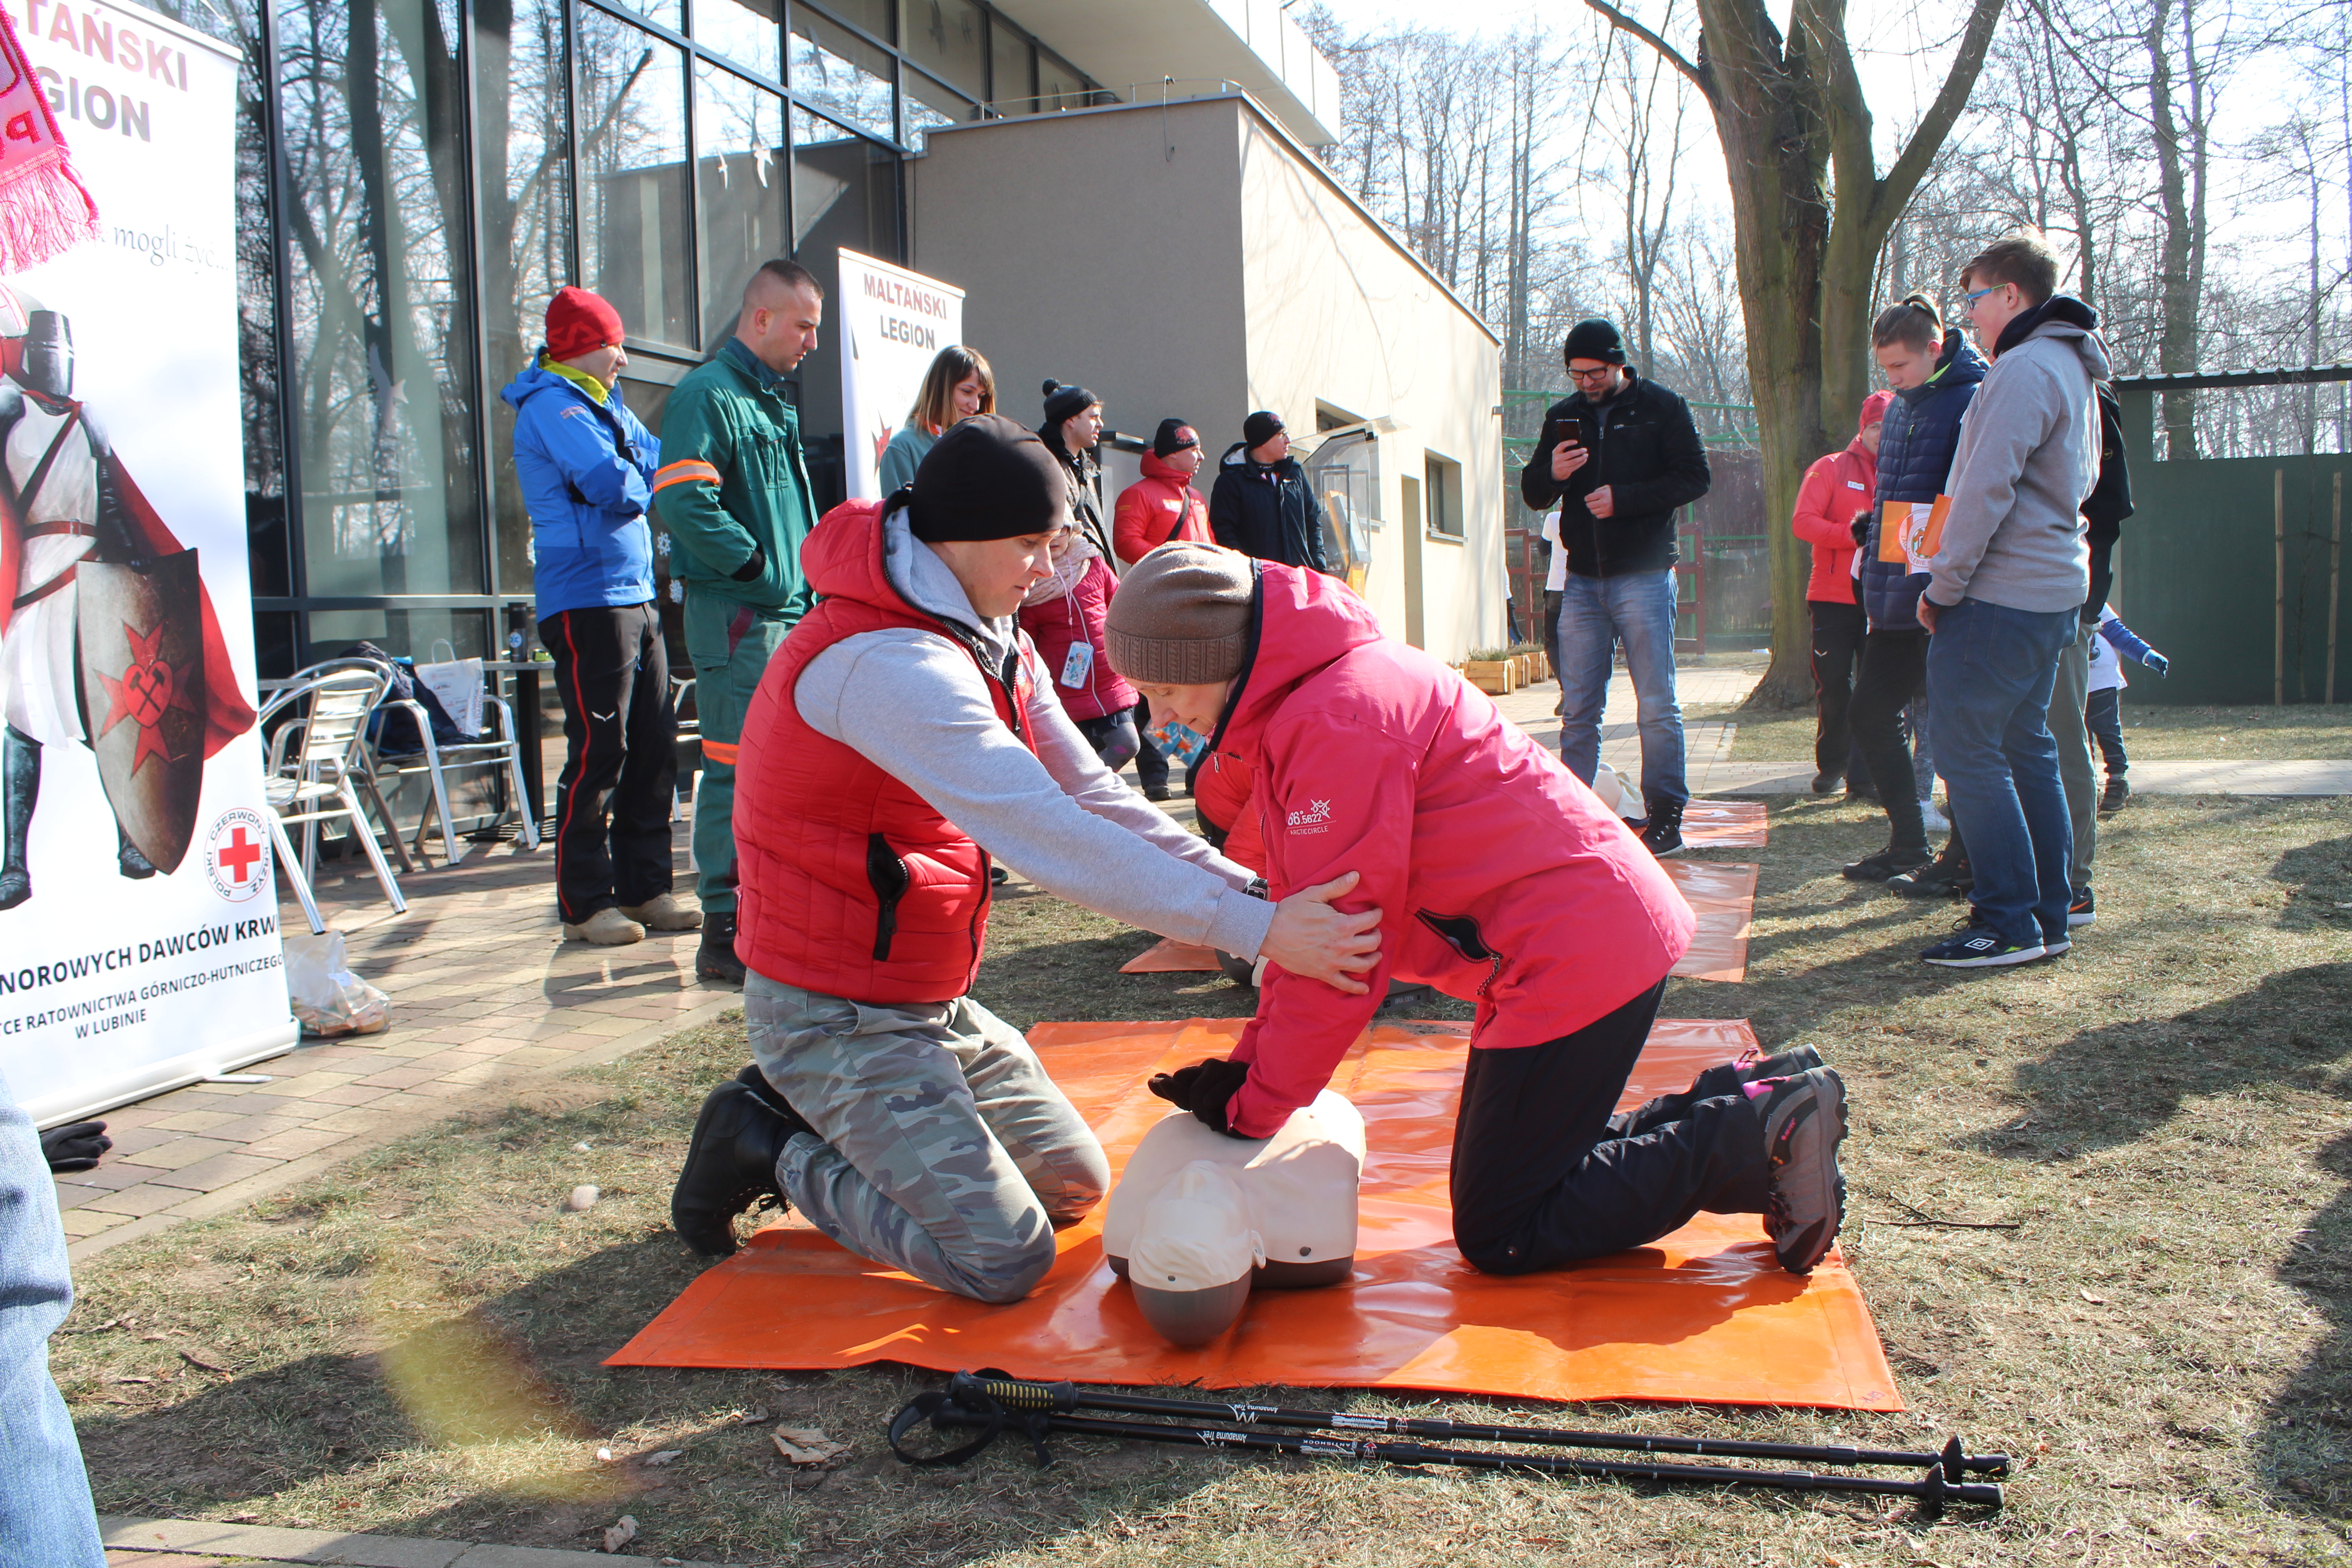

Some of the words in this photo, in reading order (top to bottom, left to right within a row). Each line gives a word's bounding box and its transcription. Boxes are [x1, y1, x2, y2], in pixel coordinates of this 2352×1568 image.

[113, 224, 179, 267] mogli
[863, 272, 947, 320] MALTAŃSKI
[880, 315, 936, 350] LEGION
[210, 811, 266, 841] CZERWONY
[206, 852, 232, 897] POLSKI
[140, 924, 230, 963] DAWCÓW
[26, 990, 137, 1030] RATOWNICTWA
[141, 953, 283, 1000] GÓRNICZO-HUTNICZEGO
[75, 1023, 89, 1039] W
[93, 1008, 147, 1034] LUBINIE
[1203, 1431, 1215, 1441] Trek
[1216, 1431, 1247, 1443] Annapurna
